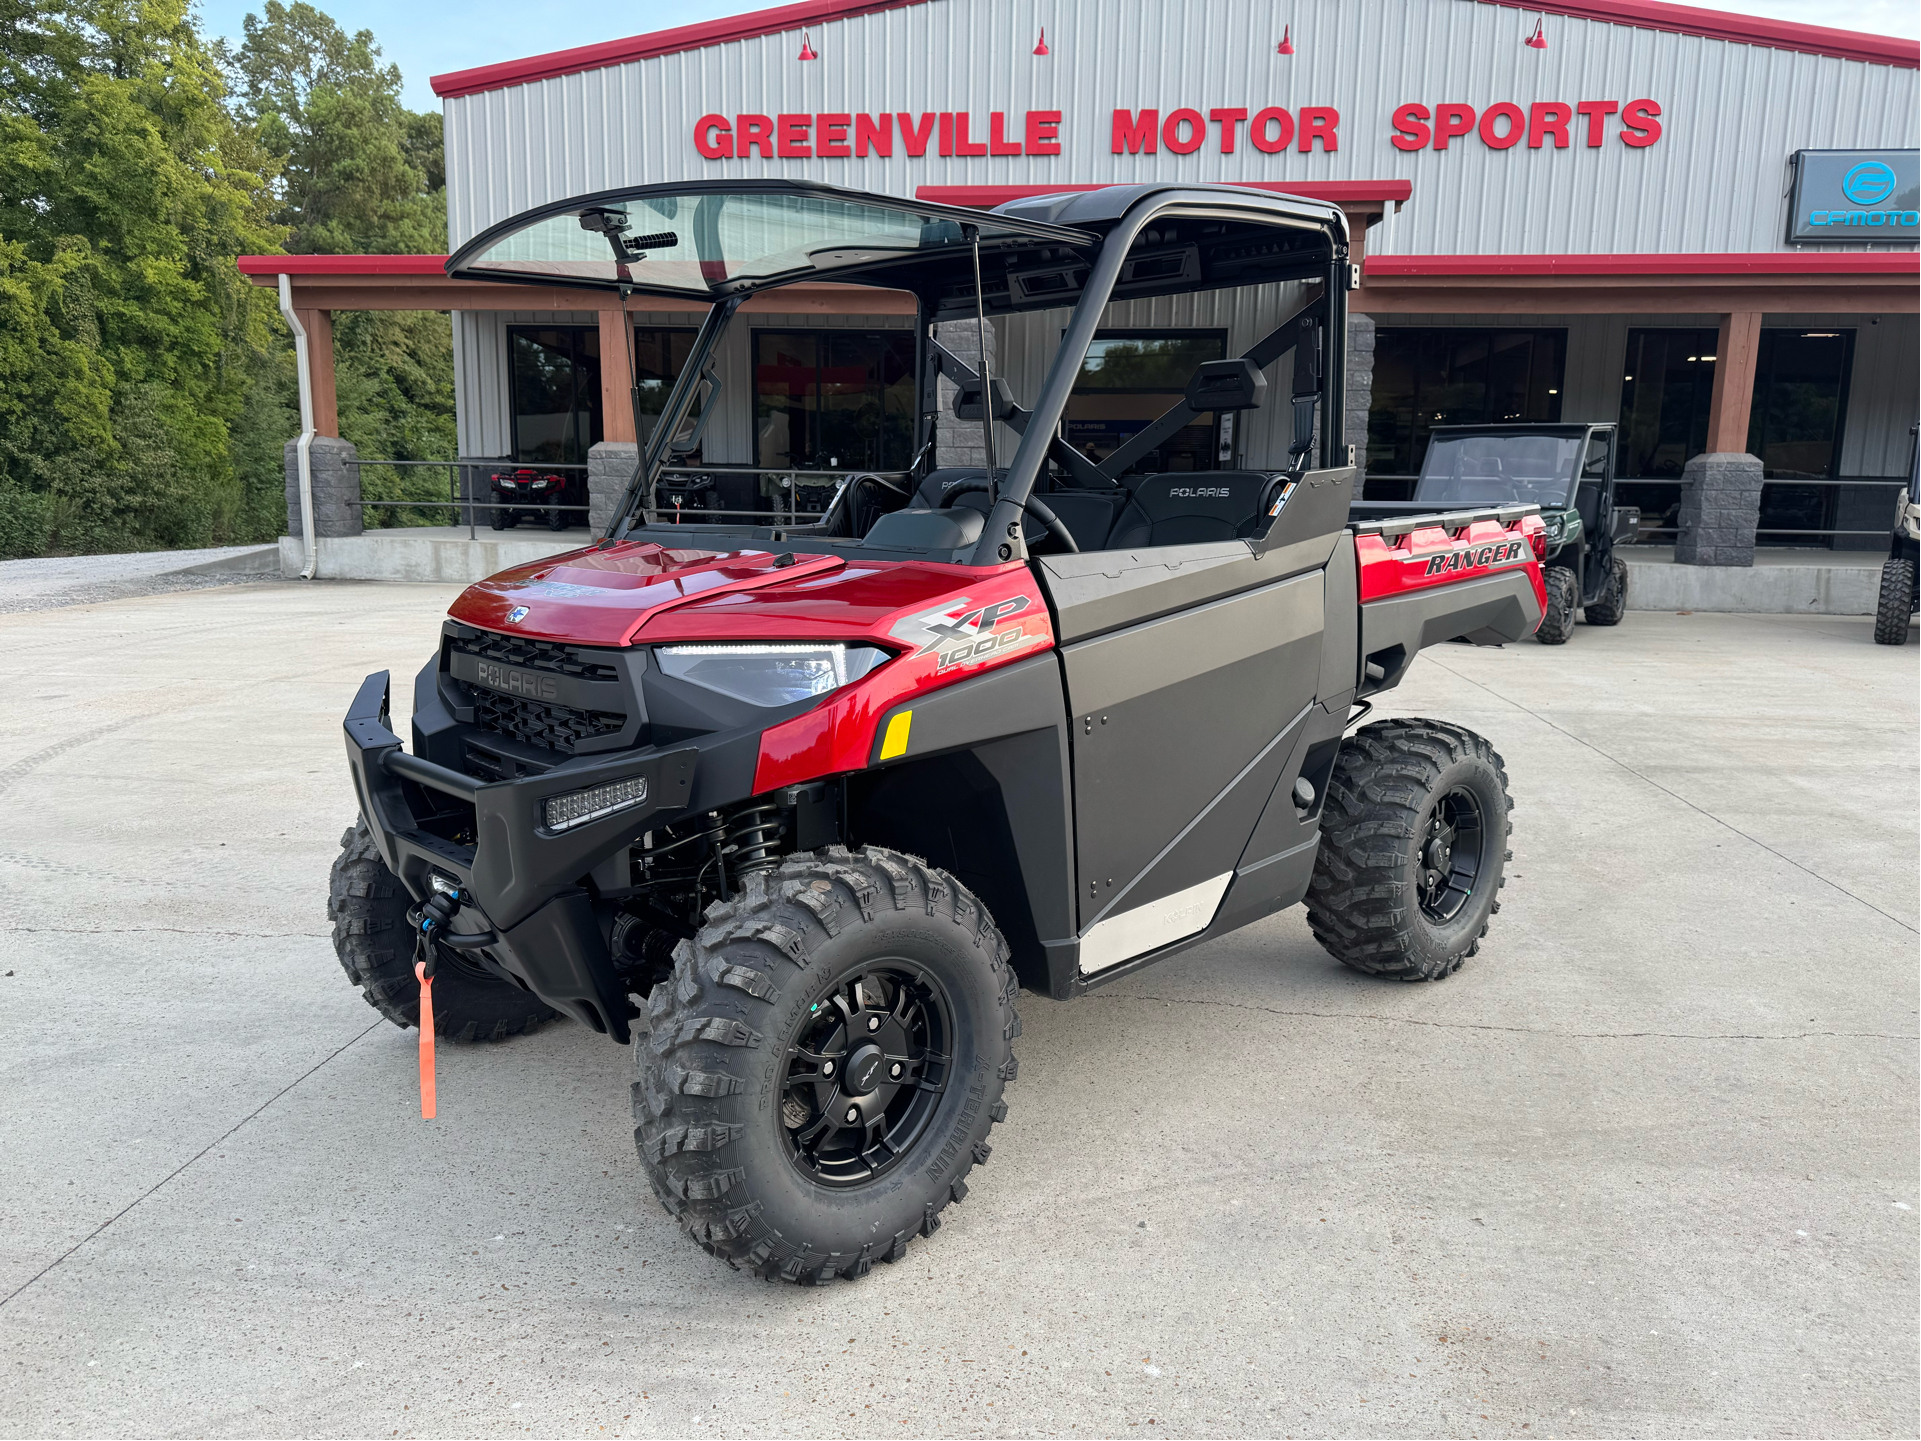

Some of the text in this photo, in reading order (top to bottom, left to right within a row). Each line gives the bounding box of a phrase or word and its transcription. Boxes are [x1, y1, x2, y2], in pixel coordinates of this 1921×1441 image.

[693, 99, 1663, 159] GREENVILLE MOTOR SPORTS
[1809, 210, 1920, 227] CFMOTO
[1169, 486, 1230, 498] POLARIS
[1424, 541, 1522, 577] RANGER
[909, 594, 1031, 660] XP
[936, 627, 1023, 671] 1000
[936, 643, 1019, 676] DUAL OVERHEAD CAM
[477, 661, 557, 699] POLARIS
[1163, 900, 1204, 926] KOLPIN
[926, 1054, 992, 1184] X-TERRAIN
